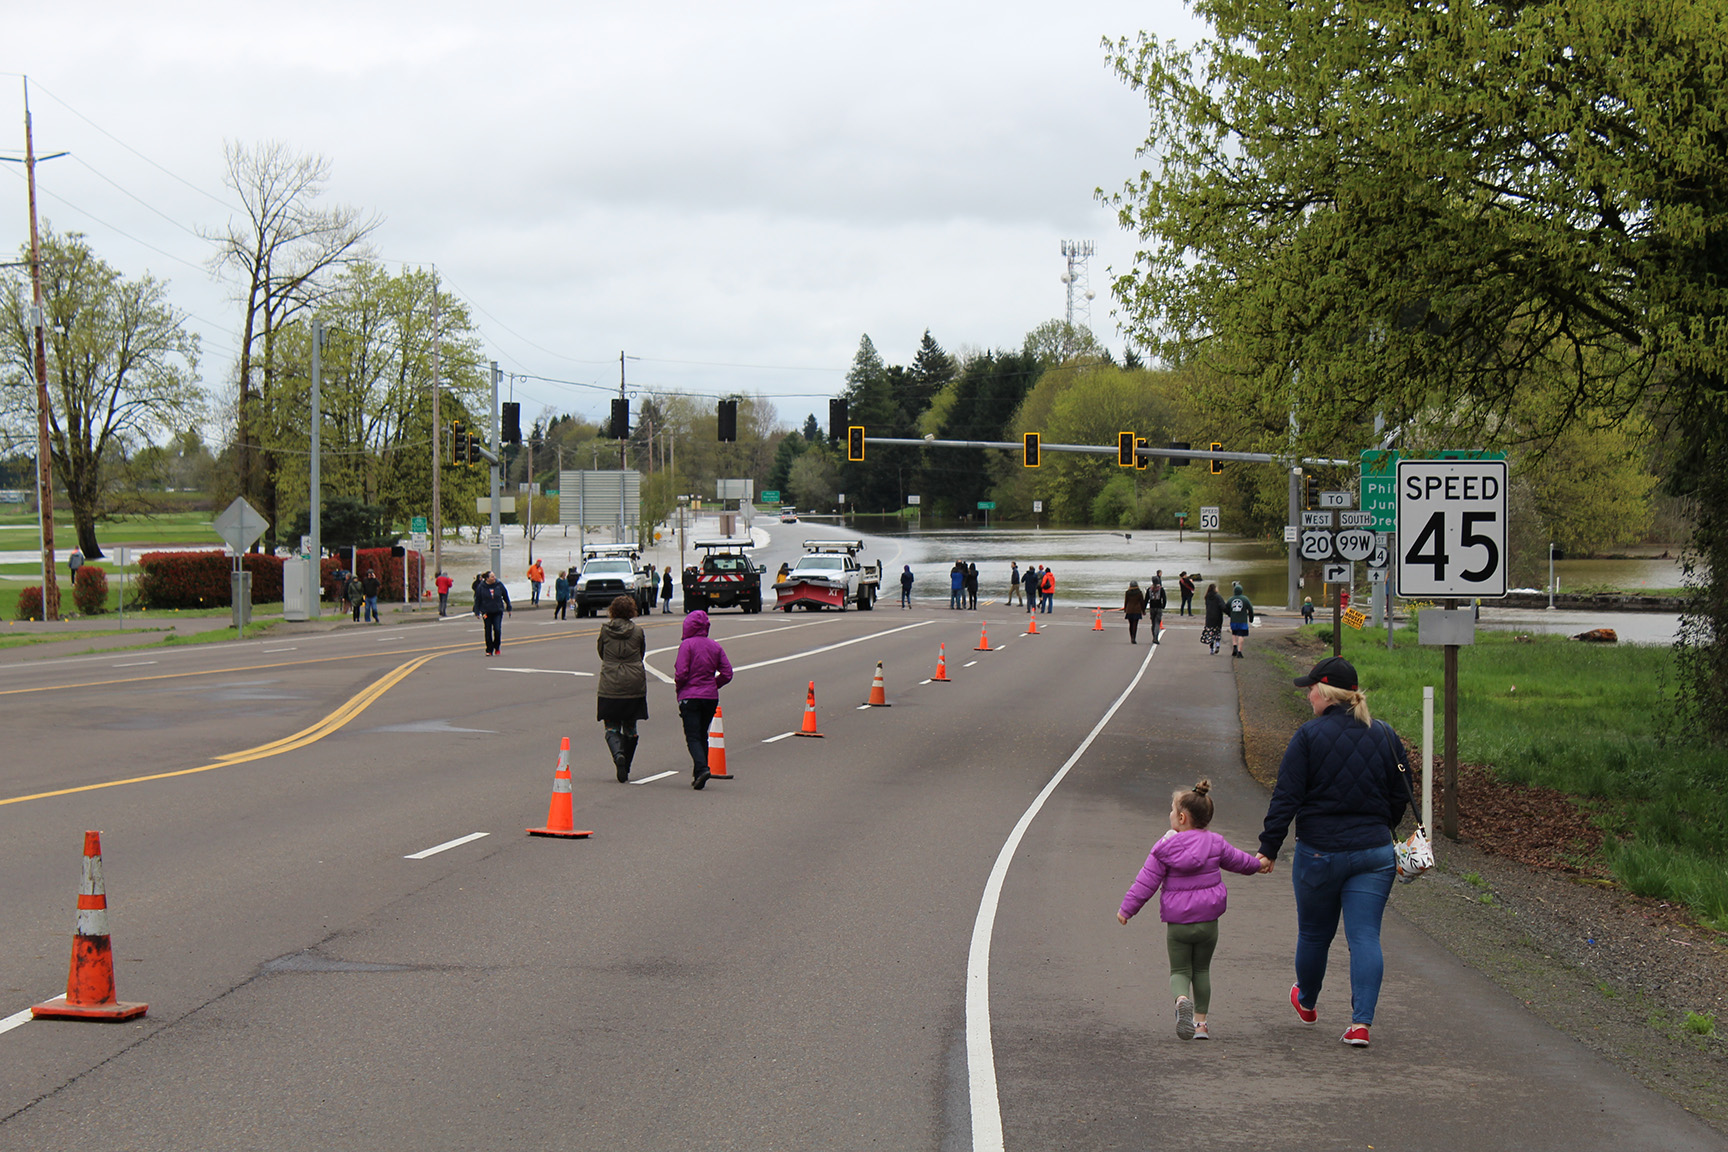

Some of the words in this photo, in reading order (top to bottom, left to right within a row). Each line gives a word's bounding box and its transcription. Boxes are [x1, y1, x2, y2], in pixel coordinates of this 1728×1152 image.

[1406, 476, 1499, 500] SPEED
[1328, 495, 1343, 504] TO
[1368, 499, 1395, 510] Jun
[1202, 514, 1218, 528] 50
[1304, 514, 1329, 524] WEST
[1341, 514, 1370, 524] SOUTH
[1305, 536, 1329, 553] 20
[1340, 535, 1370, 551] 99W
[1405, 511, 1499, 582] 45
[828, 588, 839, 597] XT
